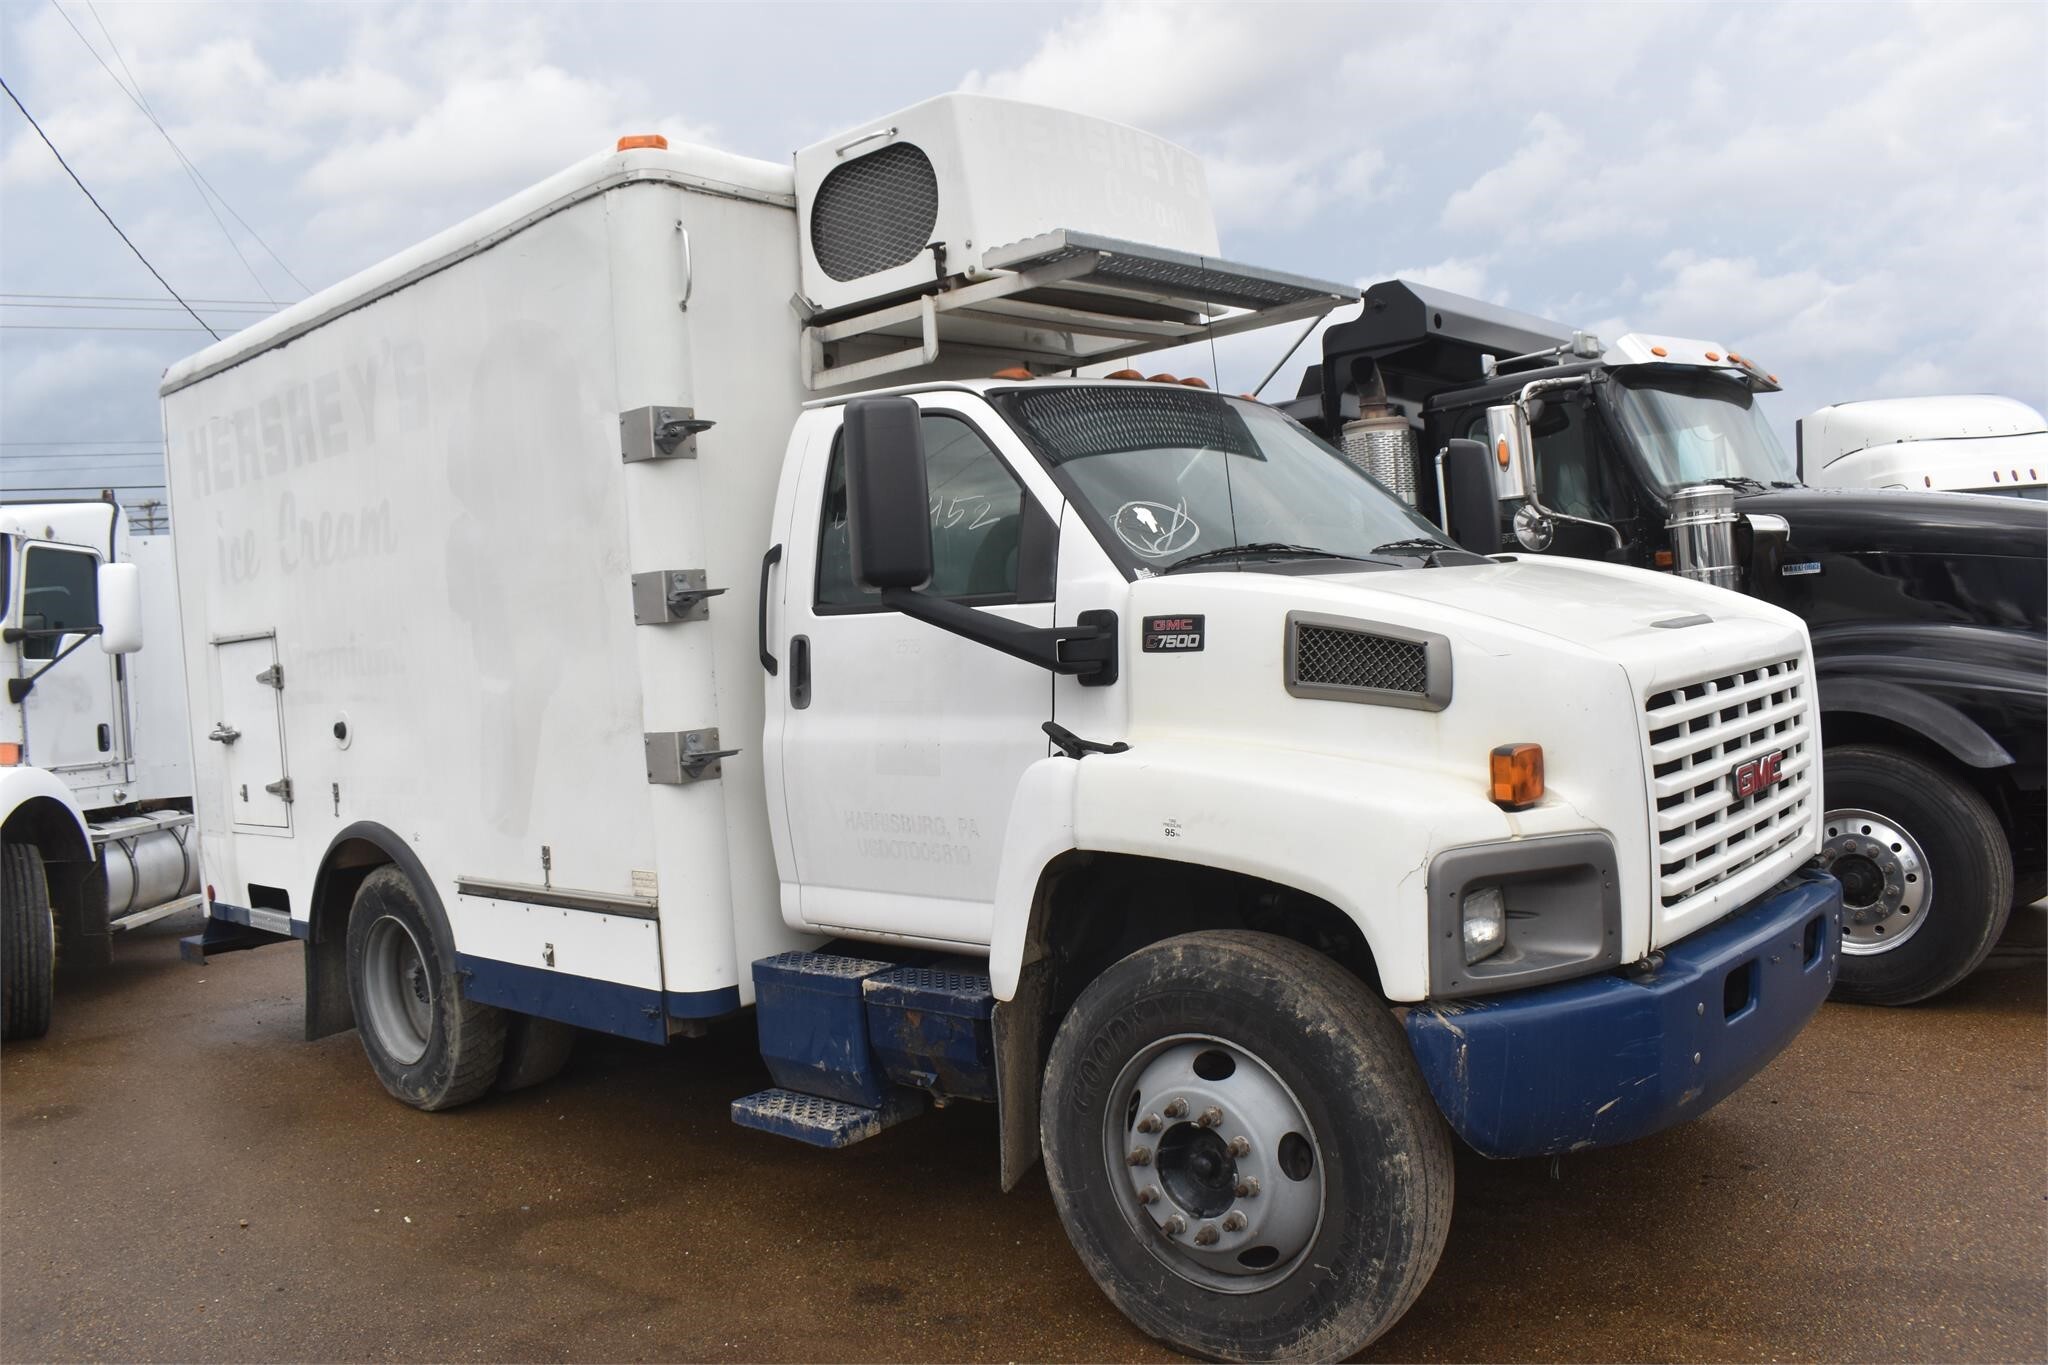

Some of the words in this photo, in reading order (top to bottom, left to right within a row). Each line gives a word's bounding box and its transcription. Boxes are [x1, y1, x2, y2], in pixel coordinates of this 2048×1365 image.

[278, 490, 399, 575] Cream
[1153, 619, 1193, 631] GMC
[1146, 634, 1200, 648] C7500
[1736, 751, 1783, 798] GMC
[1164, 827, 1176, 837] 95
